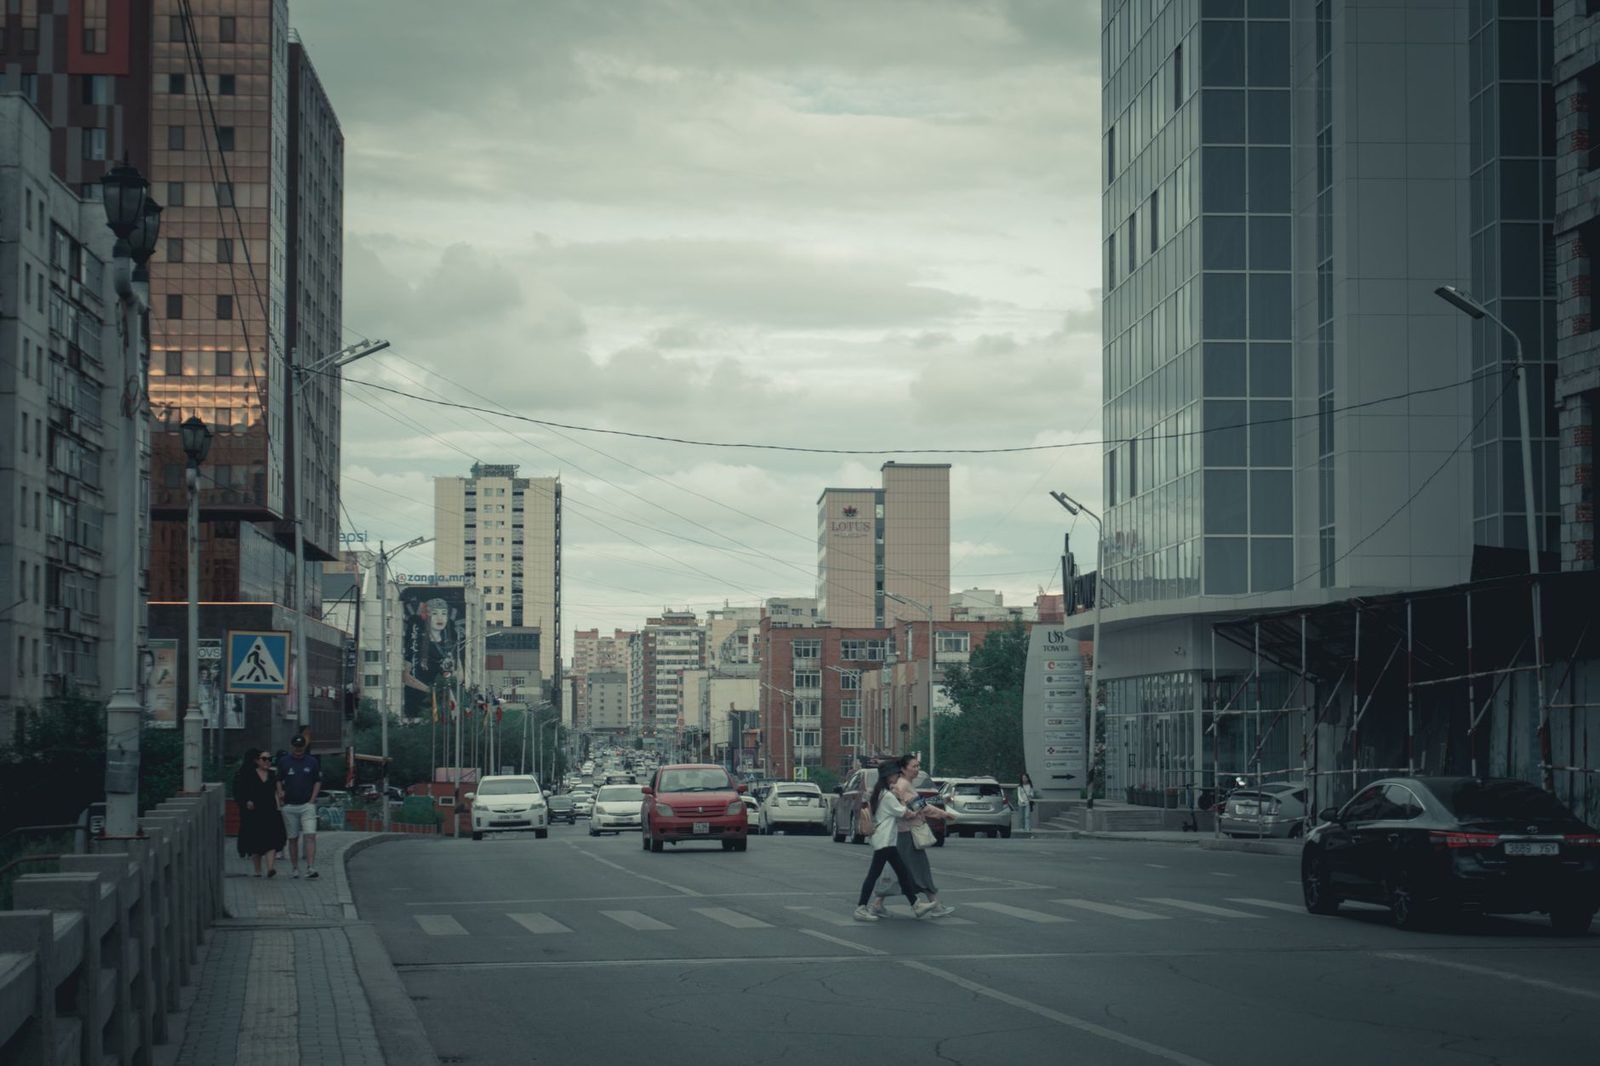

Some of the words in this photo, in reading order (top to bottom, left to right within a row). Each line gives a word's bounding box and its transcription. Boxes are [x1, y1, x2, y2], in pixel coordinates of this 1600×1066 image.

[831, 521, 871, 532] LOTUS
[196, 647, 220, 658] OVS
[1042, 644, 1069, 652] TOWER
